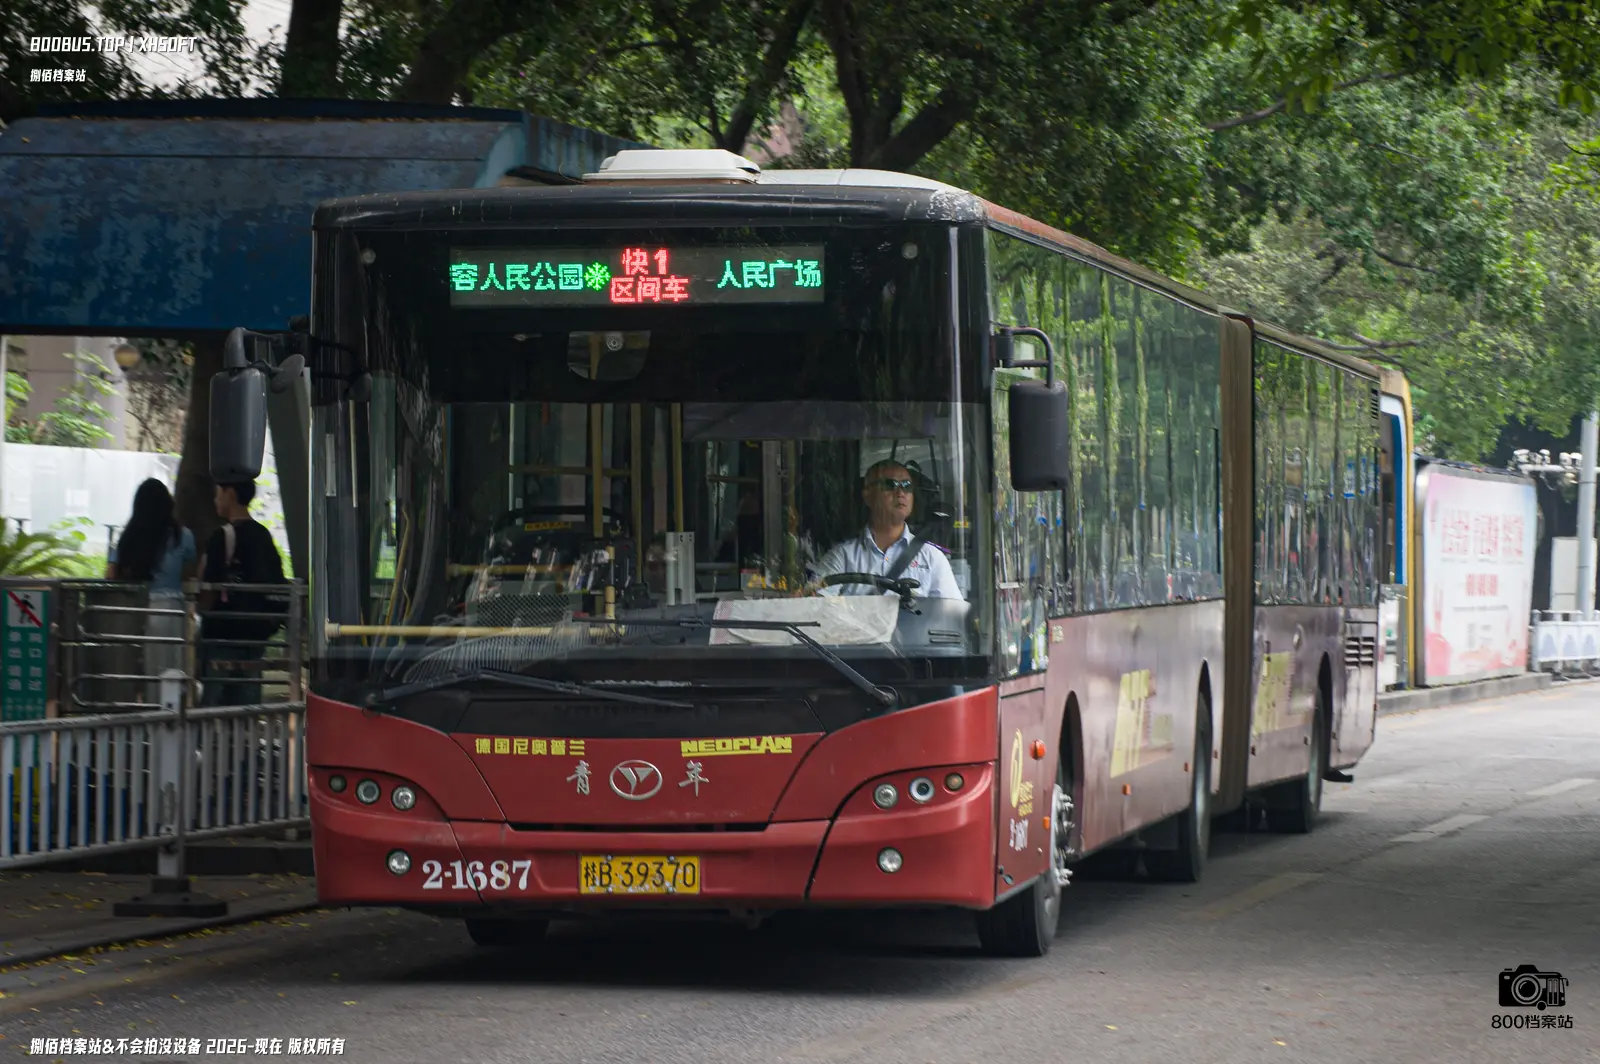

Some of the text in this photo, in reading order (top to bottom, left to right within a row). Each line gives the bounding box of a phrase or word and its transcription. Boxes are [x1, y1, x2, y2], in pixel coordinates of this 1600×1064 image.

[450, 262, 583, 291] 容人民公园
[717, 260, 822, 288] 人民广场
[610, 275, 689, 303] 区间车
[475, 738, 585, 755] 德国尼奥普兰
[681, 736, 793, 757] NEOPLAN
[422, 860, 532, 891] 2-1687
